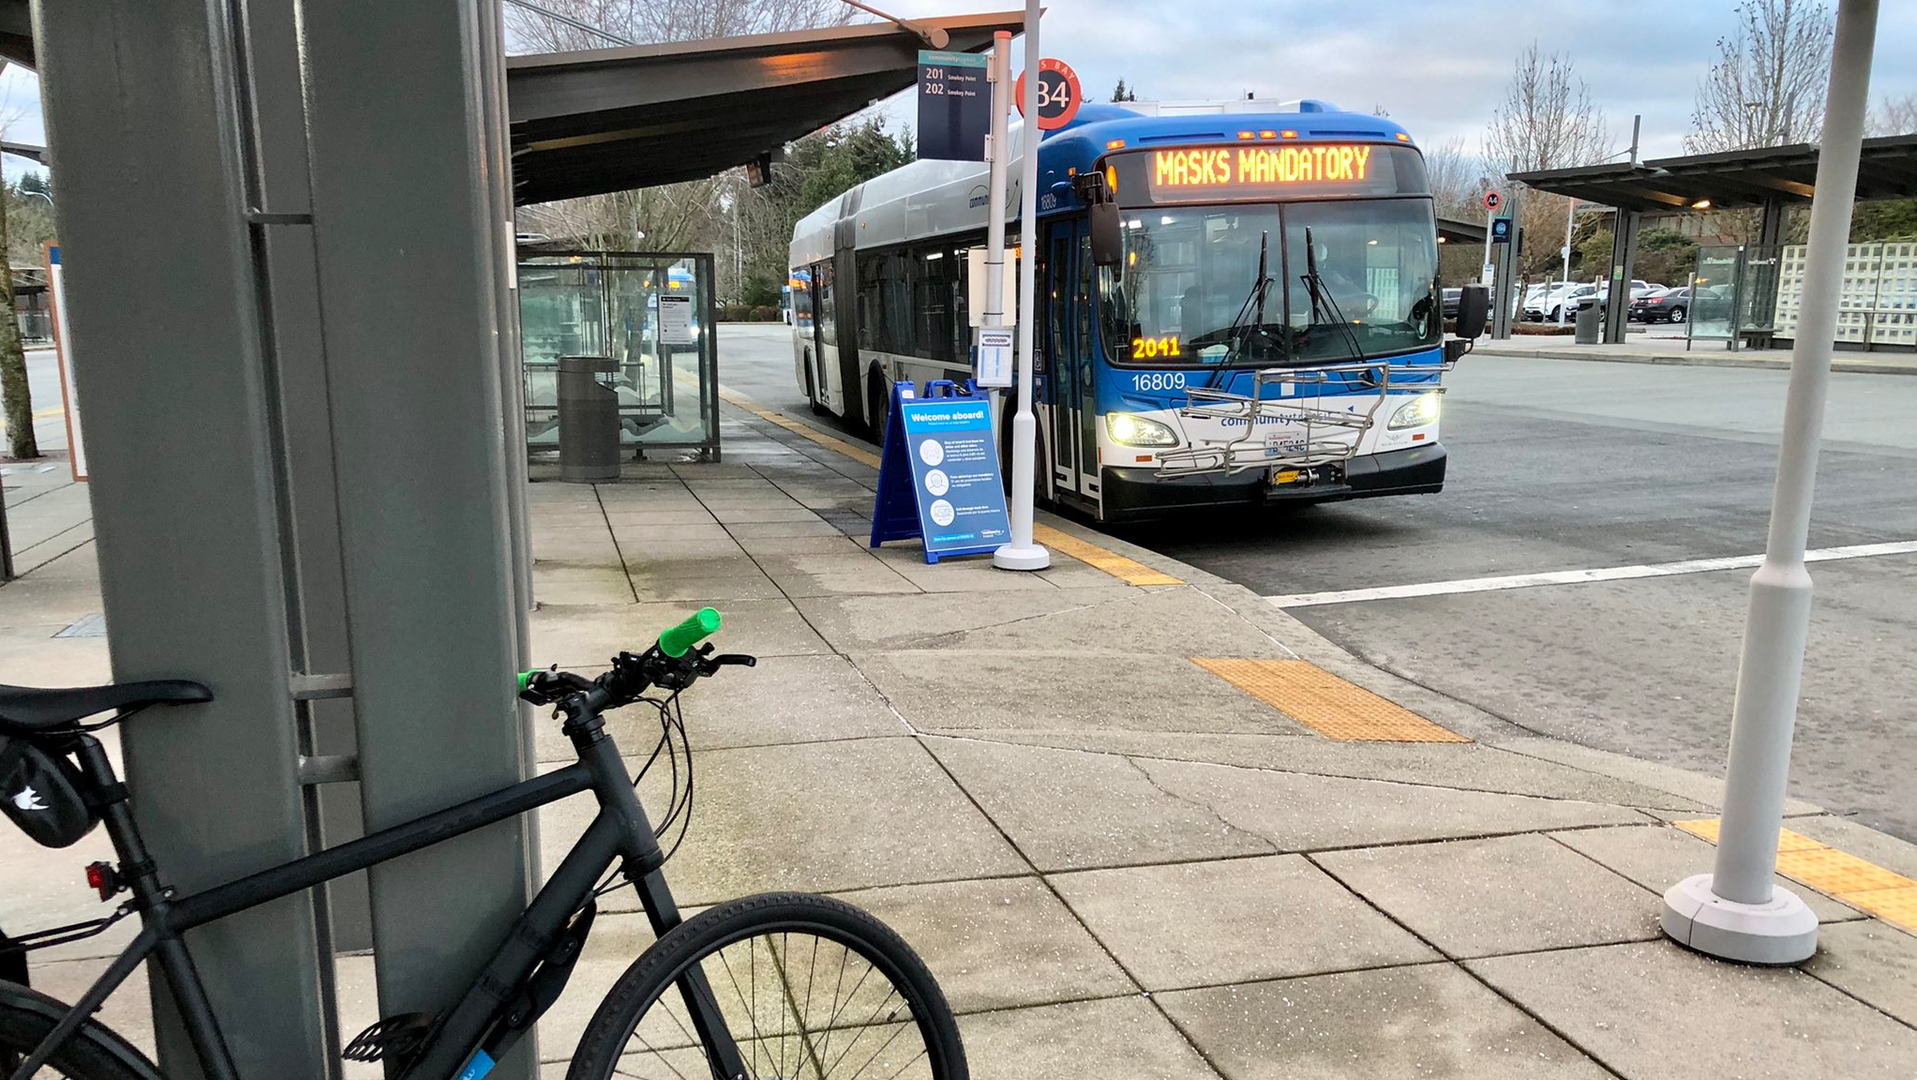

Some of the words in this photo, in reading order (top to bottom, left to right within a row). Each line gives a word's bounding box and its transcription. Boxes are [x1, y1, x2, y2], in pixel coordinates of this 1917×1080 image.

[926, 67, 944, 80] 201
[947, 74, 965, 82] Smokey
[1054, 61, 1075, 80] BAY
[925, 82, 944, 95] 202
[947, 89, 964, 97] Smokey
[1155, 150, 1231, 186] MASKS
[1238, 145, 1370, 183] MANDATORY
[1133, 336, 1180, 358] 2041
[1132, 372, 1185, 391] 16809
[911, 413, 951, 422] Welcome
[952, 410, 984, 419] aboard!
